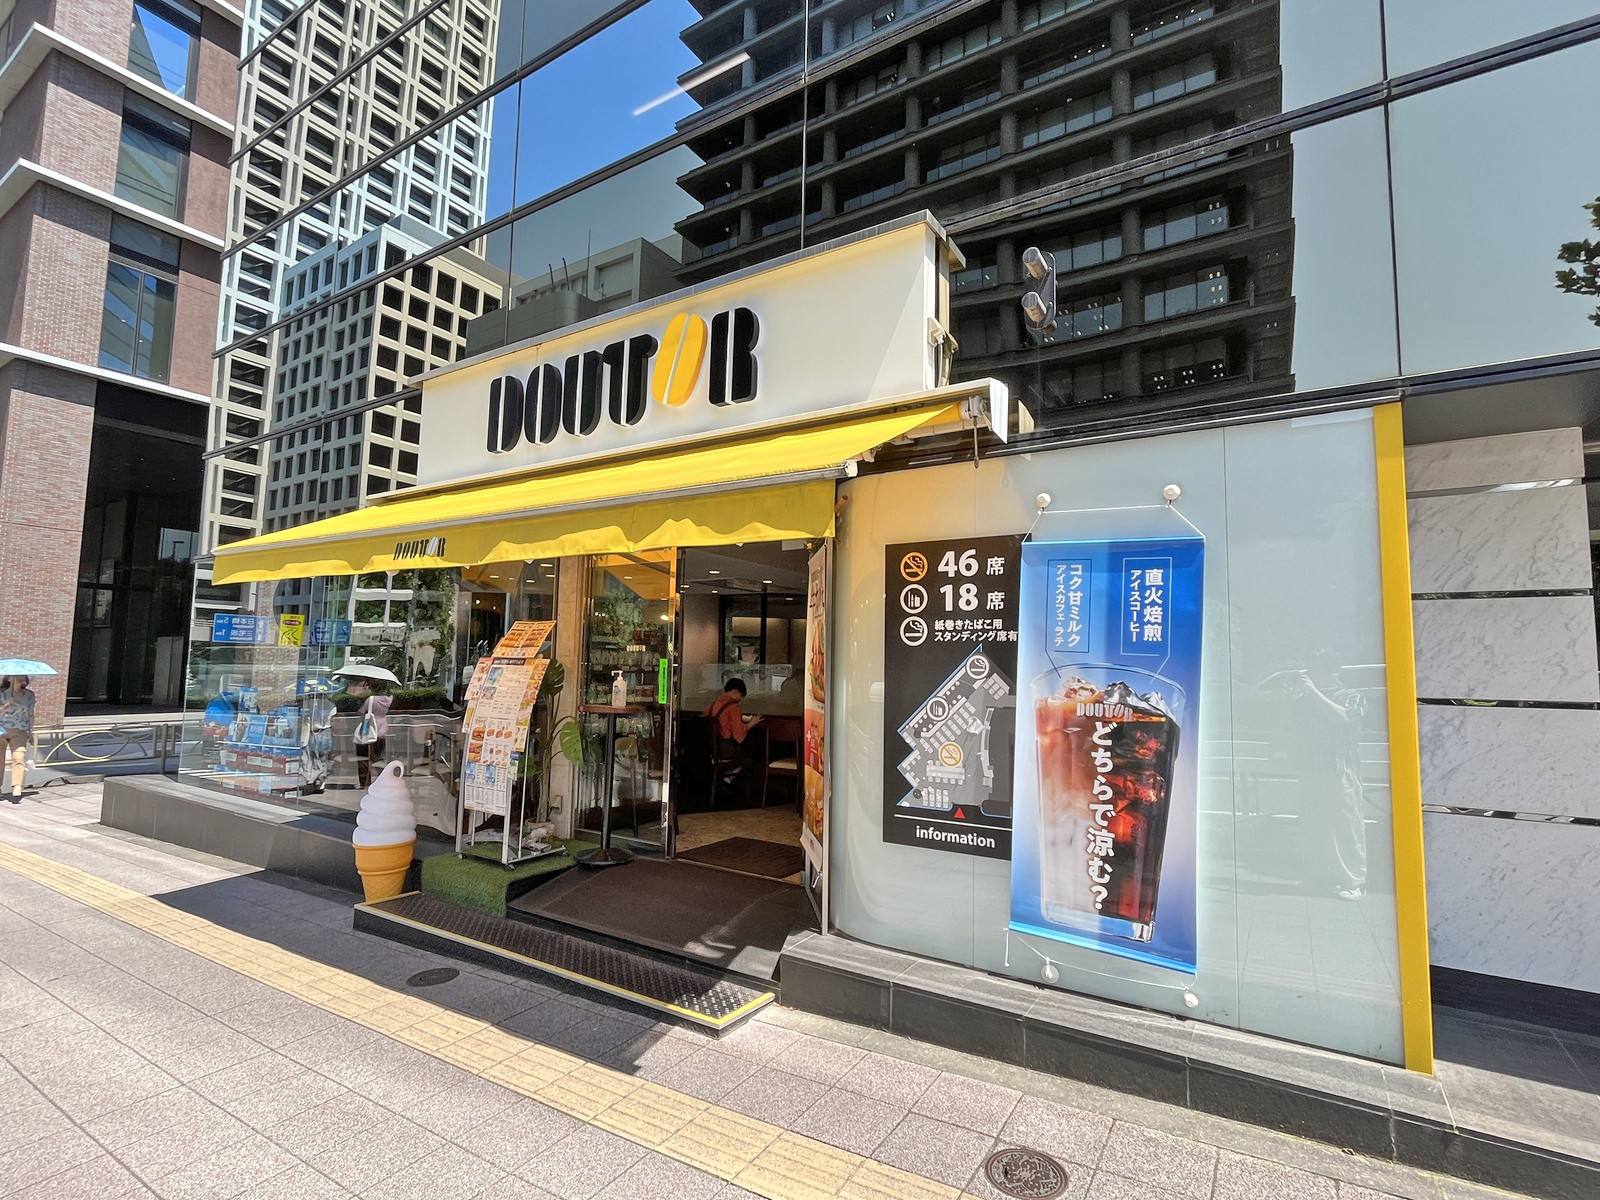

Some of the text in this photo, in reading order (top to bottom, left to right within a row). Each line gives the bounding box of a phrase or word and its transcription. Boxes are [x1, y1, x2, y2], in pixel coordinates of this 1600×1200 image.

[486, 306, 760, 455] DOUTOR
[393, 535, 446, 561] DOUTOR
[937, 548, 1005, 578] 46 席
[939, 583, 1006, 612] 18 席
[1054, 564, 1067, 647] アイスカフェ・ラテ
[1067, 564, 1084, 648] コク甘ミルク
[1129, 569, 1143, 643] アイスコーヒー
[1142, 568, 1164, 642] 直火焙煎
[934, 619, 1003, 631] 紙巻きたばこ用
[1076, 702, 1135, 722] DOUTOR
[916, 825, 996, 849] information
[1086, 721, 1118, 911] どちらで涼む？
